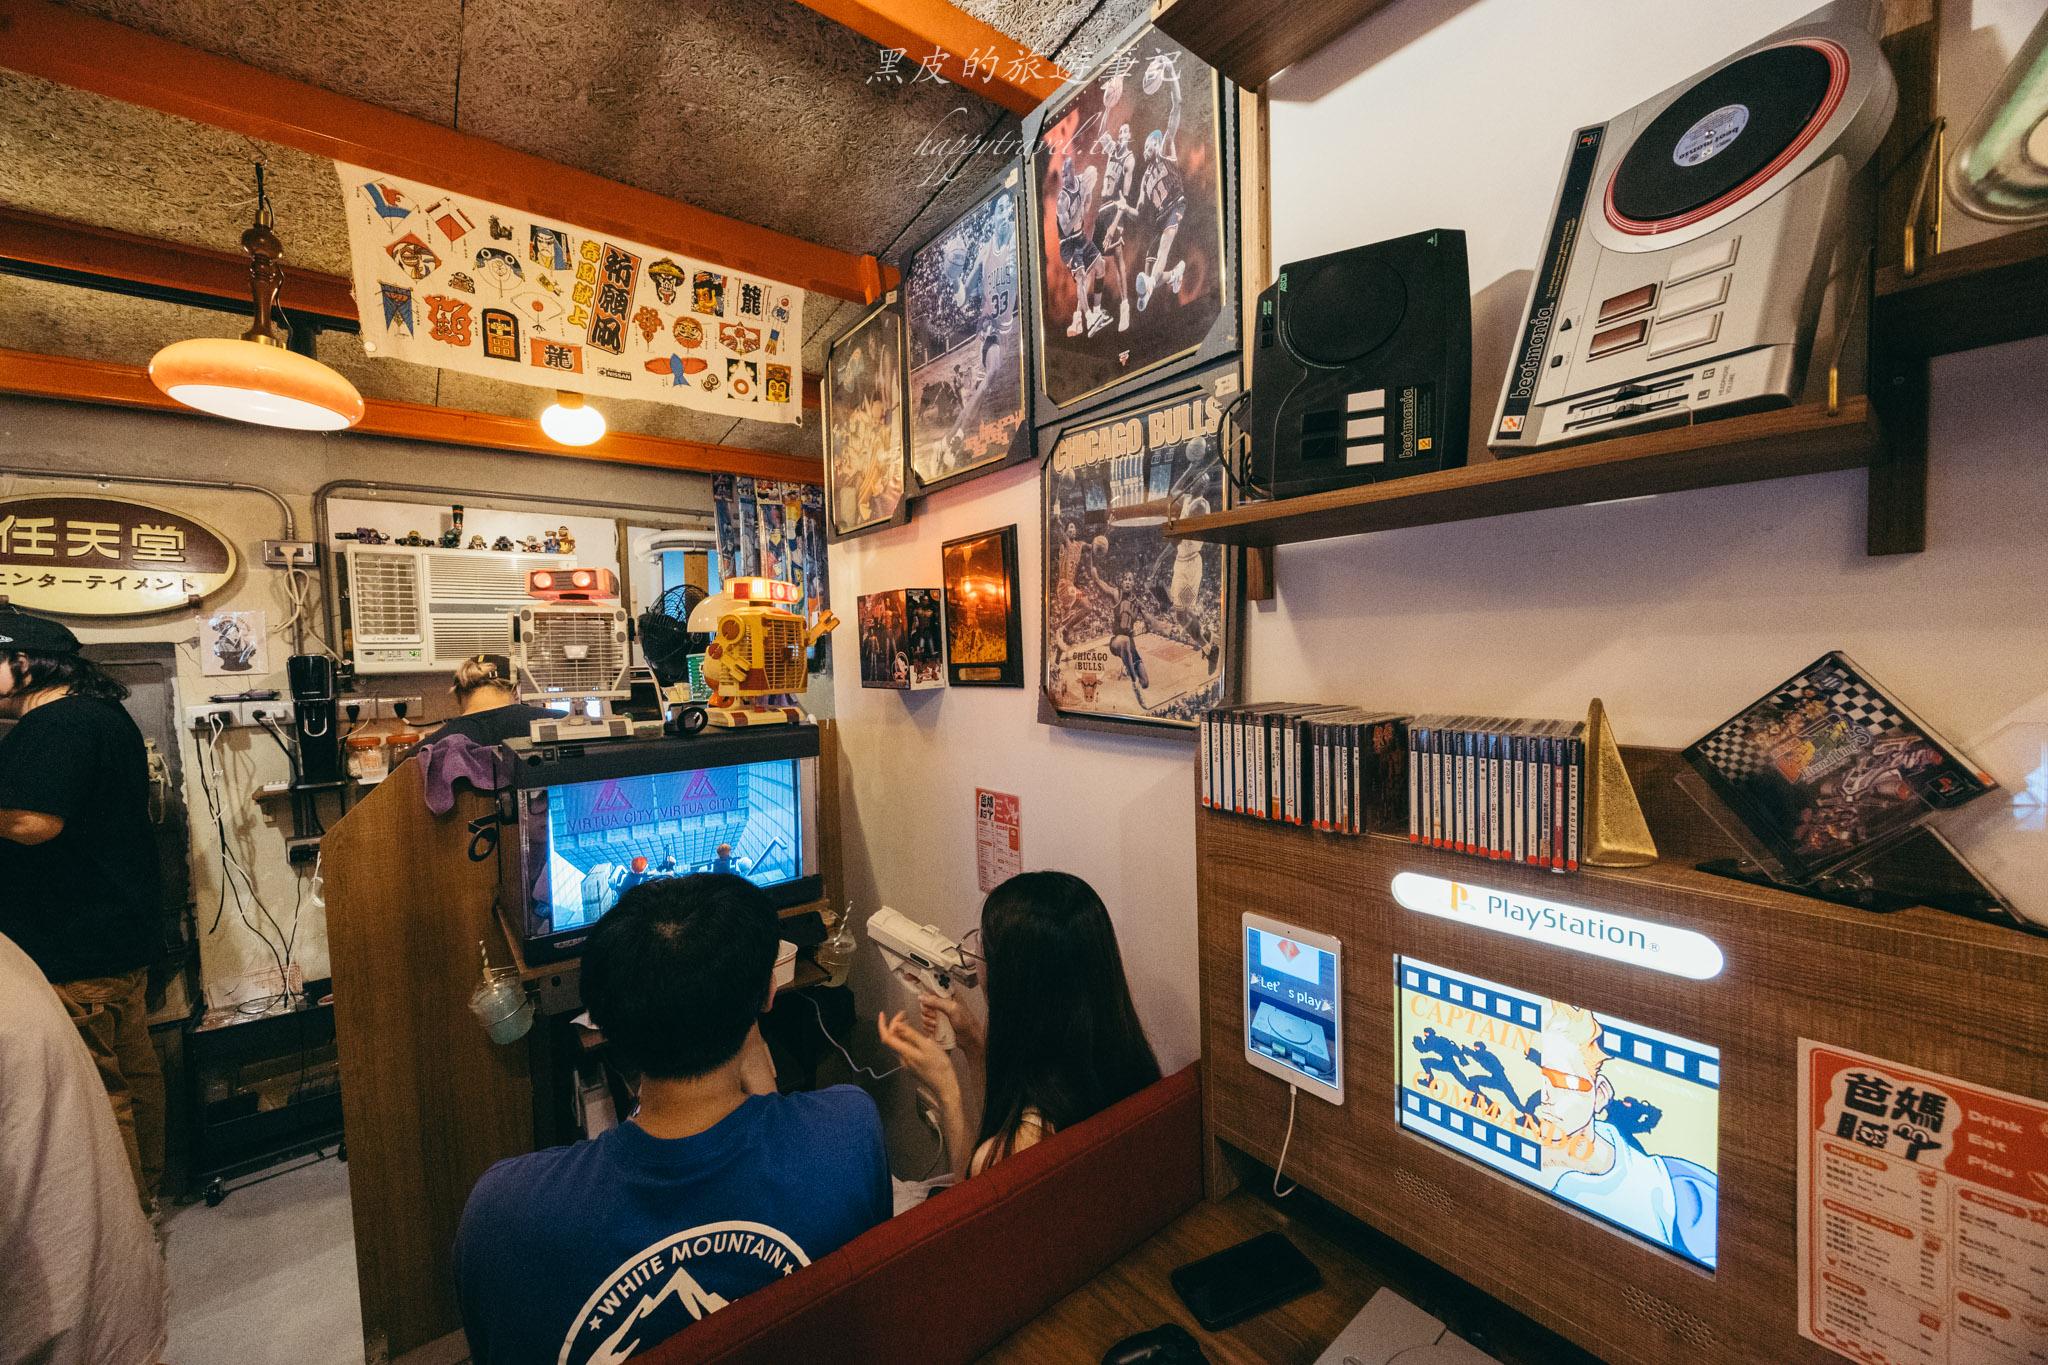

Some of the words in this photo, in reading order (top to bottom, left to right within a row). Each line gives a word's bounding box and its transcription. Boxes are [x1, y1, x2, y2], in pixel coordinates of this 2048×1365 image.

[991, 290, 1009, 319] 33
[1510, 304, 1554, 399] beatmania
[1053, 418, 1144, 474] CHICAGO
[1148, 396, 1223, 450] BULLS
[1399, 388, 1414, 458] beatmania
[0, 515, 185, 562] 任天堂
[1072, 651, 1108, 662] CHICAGO
[1077, 662, 1103, 672] BULLS
[567, 814, 618, 832] VIRTUA
[623, 808, 654, 824] CITY
[658, 803, 705, 820] VIRTUA
[708, 797, 736, 811] CITY
[1487, 895, 1646, 950] PlayStation
[1297, 991, 1322, 1010] play
[1410, 994, 1541, 1056] CAPTAIN
[1412, 1070, 1595, 1161] COMMANDO
[1967, 1109, 2024, 1134] Drink
[1967, 1132, 2008, 1153] Eat
[1967, 1154, 2016, 1179] Play
[596, 1253, 666, 1317] WHITE
[670, 1232, 787, 1269] MOUNTAIN
